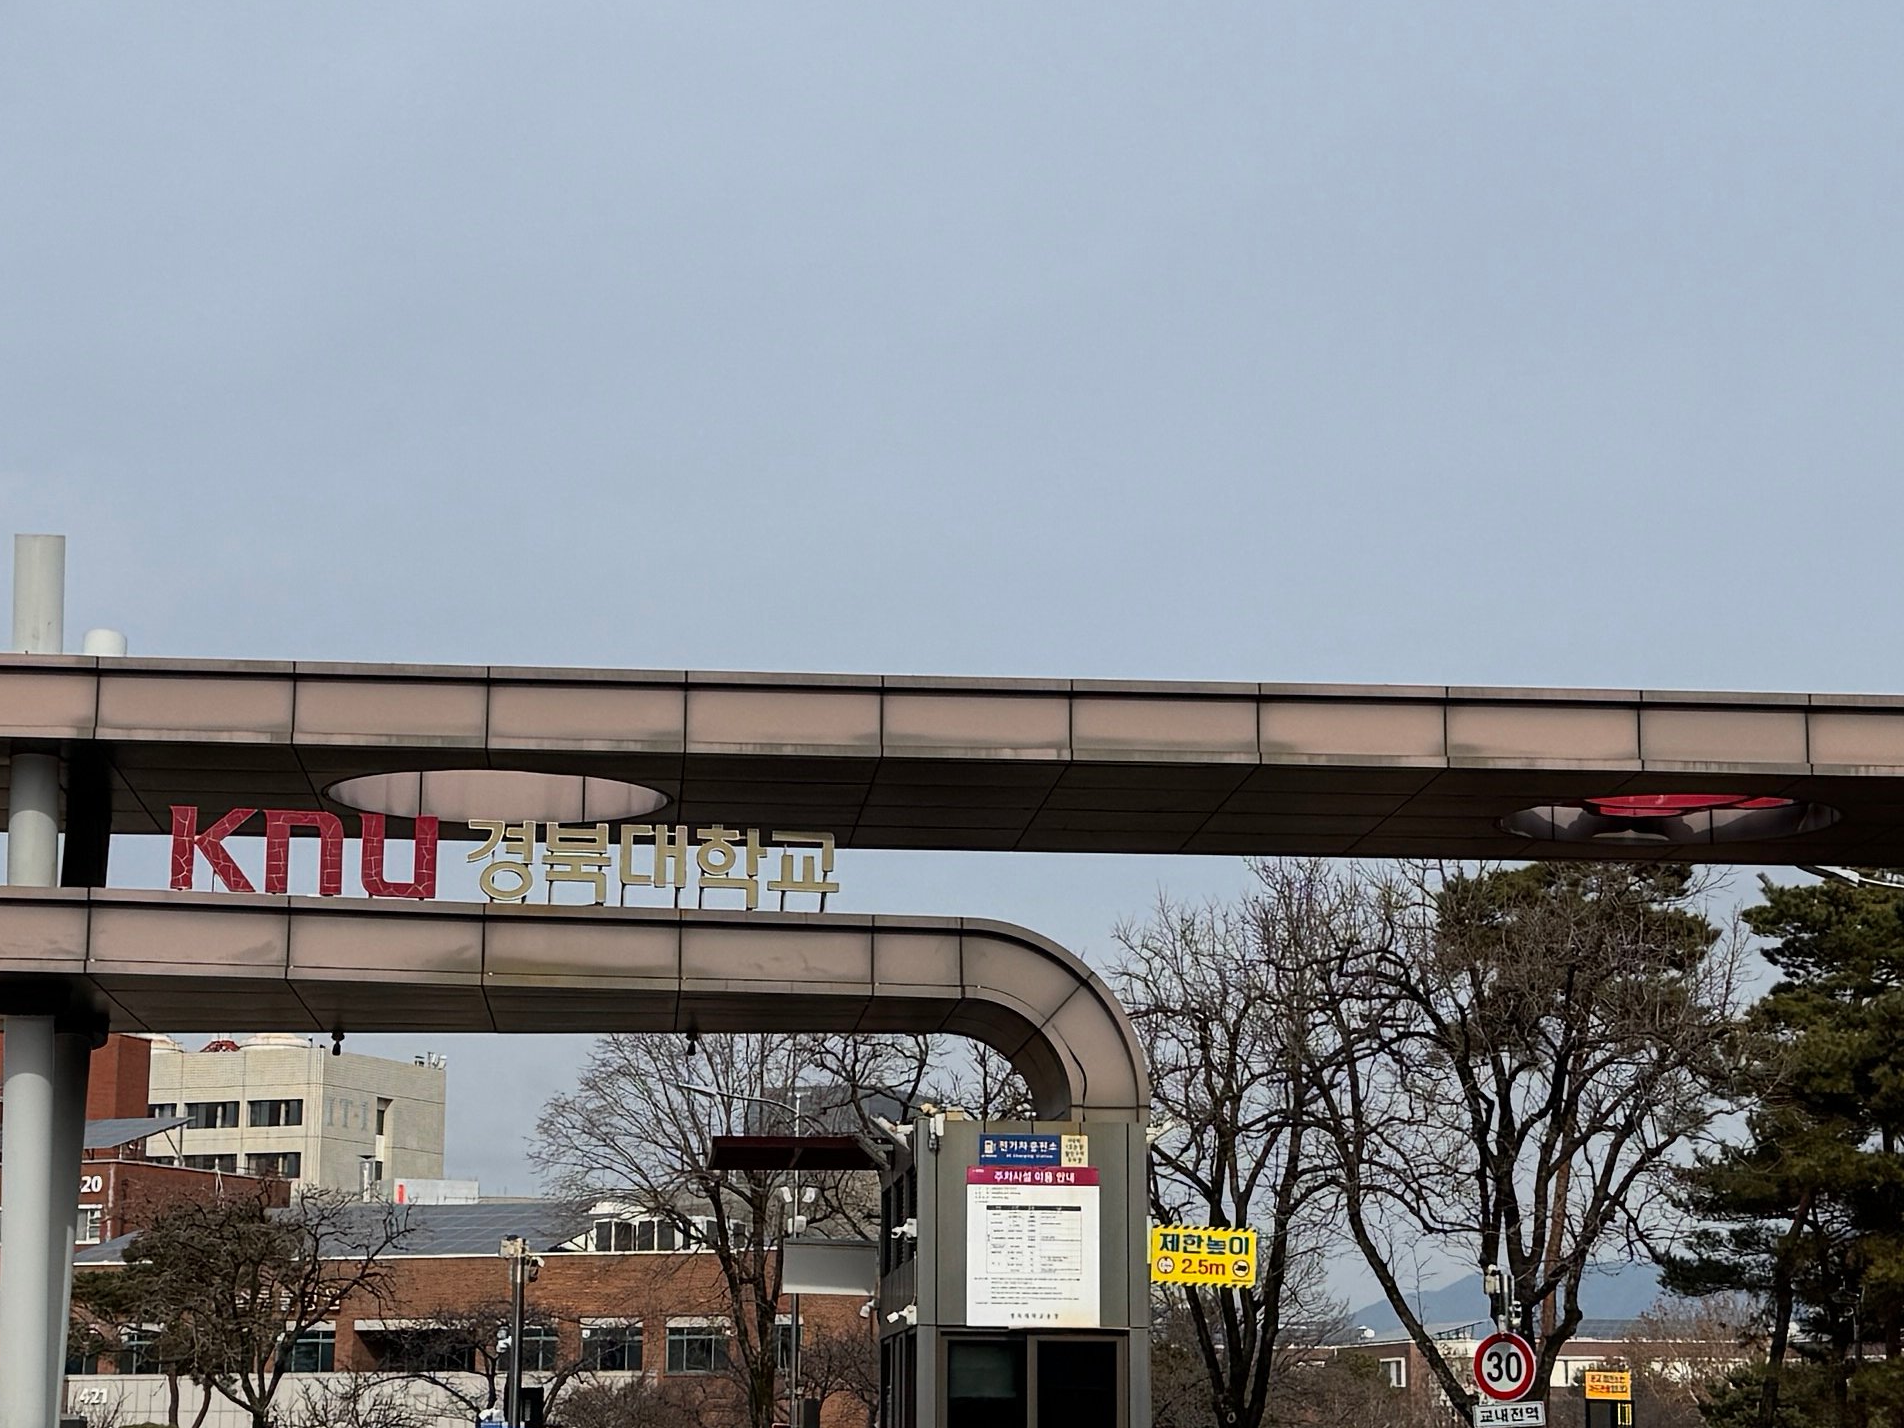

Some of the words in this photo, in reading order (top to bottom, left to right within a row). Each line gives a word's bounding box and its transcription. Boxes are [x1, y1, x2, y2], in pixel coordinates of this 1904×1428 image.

[467, 818, 841, 910] 경북대학교
[80, 1175, 103, 1193] 20
[994, 1170, 1032, 1183] 주차시설
[1034, 1171, 1053, 1183] 이용
[1056, 1172, 1075, 1184] 안내
[1159, 1233, 1250, 1256] 제한높이
[1181, 1258, 1226, 1275] 2.5m
[1487, 1351, 1523, 1383] 30
[79, 1387, 108, 1405] 421
[1479, 1406, 1539, 1423] 교내전역
